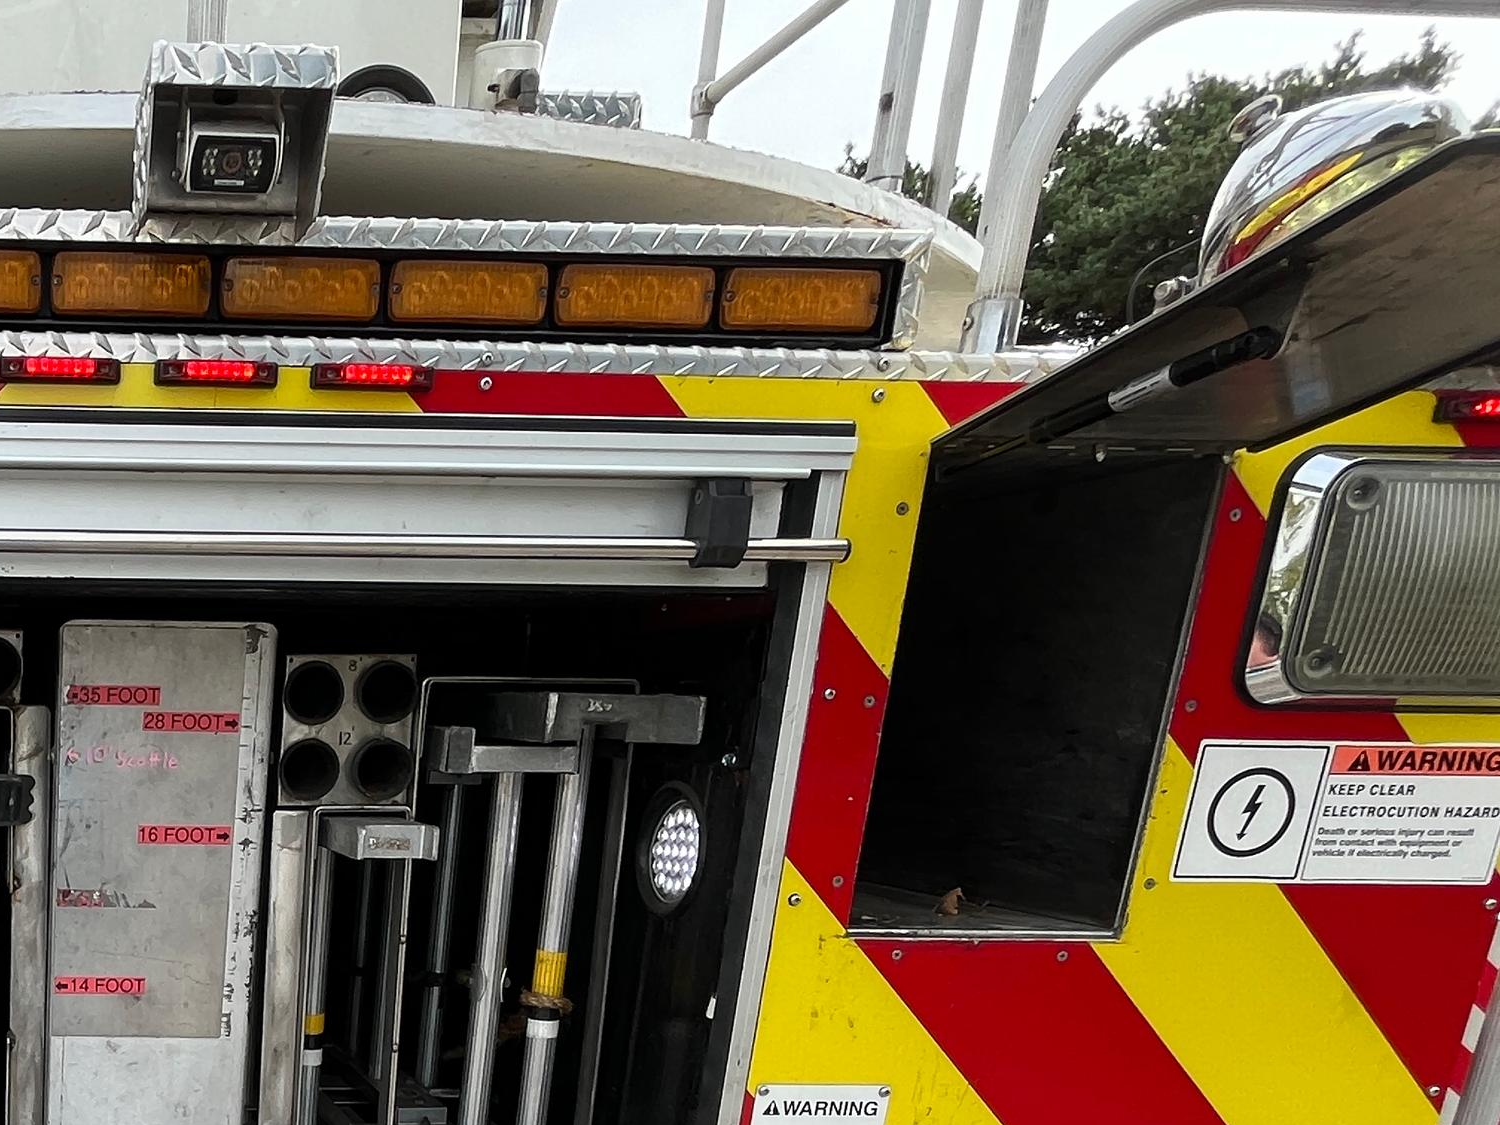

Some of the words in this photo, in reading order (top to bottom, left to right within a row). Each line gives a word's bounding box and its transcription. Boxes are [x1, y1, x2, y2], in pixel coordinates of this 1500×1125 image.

[79, 687, 100, 703] 35
[107, 687, 160, 703] FOOT
[144, 714, 165, 729] 28
[171, 714, 224, 730] FOOT
[1378, 750, 1500, 772] WARNING
[1328, 784, 1365, 796] KEEP
[1370, 784, 1416, 796] CLEAR
[1322, 806, 1440, 818] ELECTROCUTION
[1444, 807, 1500, 818] HAZARD
[139, 827, 158, 842] 16
[164, 827, 216, 843] FOOT
[1318, 827, 1345, 836] Death
[1360, 828, 1395, 836] serious
[1398, 828, 1425, 838] injury
[1446, 828, 1474, 836] result
[1399, 839, 1450, 848] equipment
[1312, 849, 1345, 857] vehicle
[1348, 849, 1355, 857] if
[1356, 849, 1409, 859] electrically
[1410, 849, 1452, 859] charged.
[71, 978, 89, 993] 14
[96, 978, 145, 993] FOOT
[783, 1101, 879, 1116] WARNING
